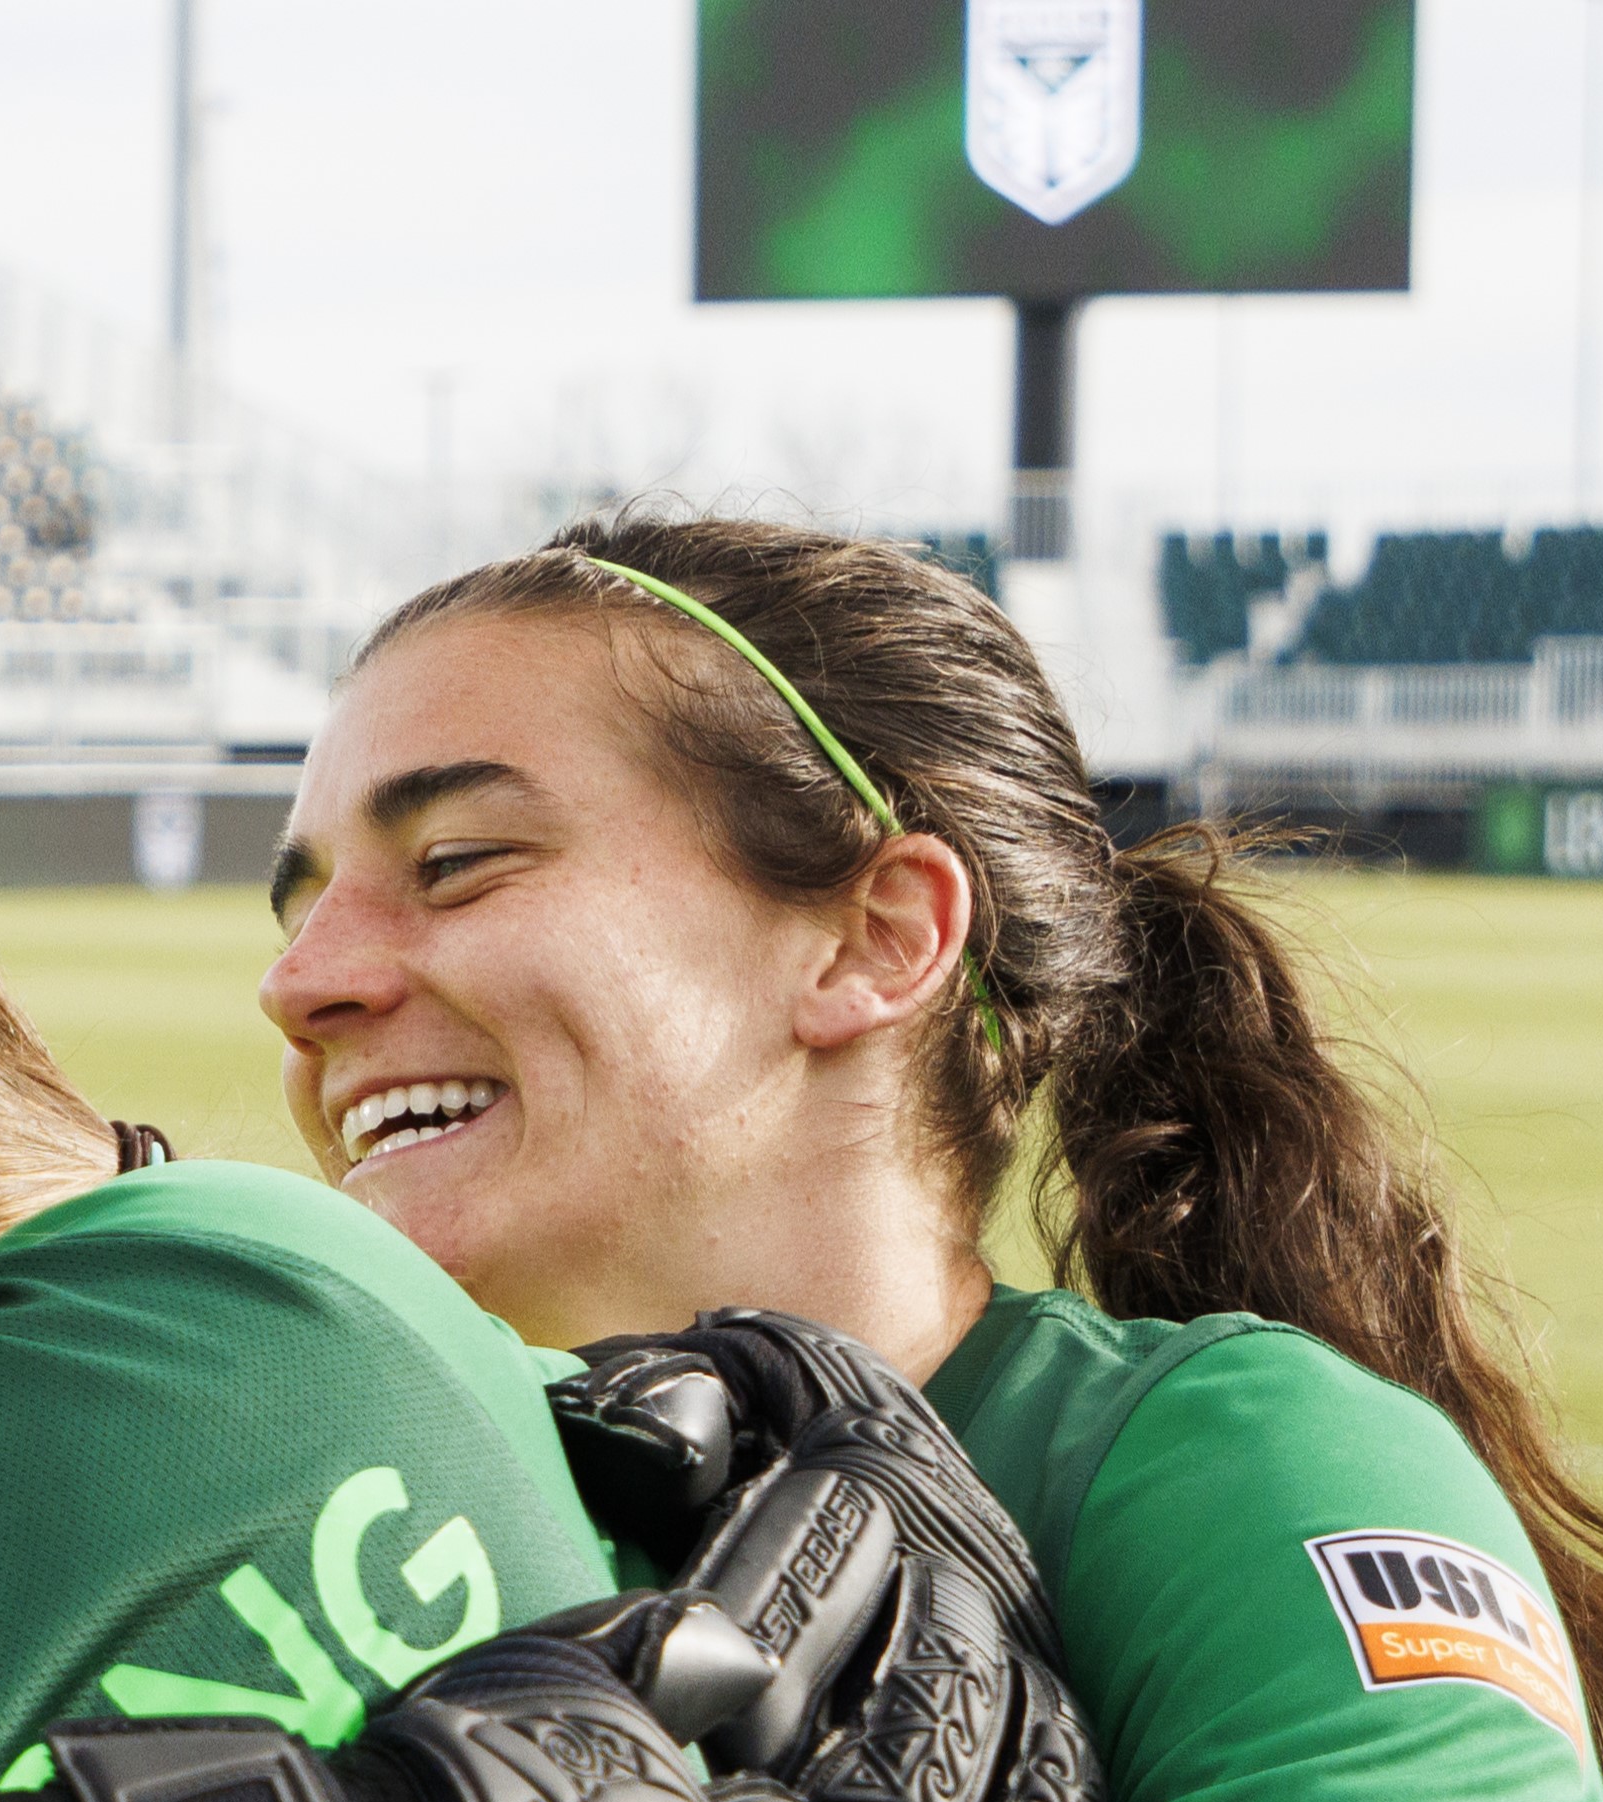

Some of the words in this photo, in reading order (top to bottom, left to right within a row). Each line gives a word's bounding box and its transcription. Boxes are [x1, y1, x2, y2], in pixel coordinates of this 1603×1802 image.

[753, 1573, 812, 1664] ST
[788, 1472, 876, 1599] COAST
[1344, 1550, 1532, 1650] USL
[1381, 1632, 1486, 1663] Super
